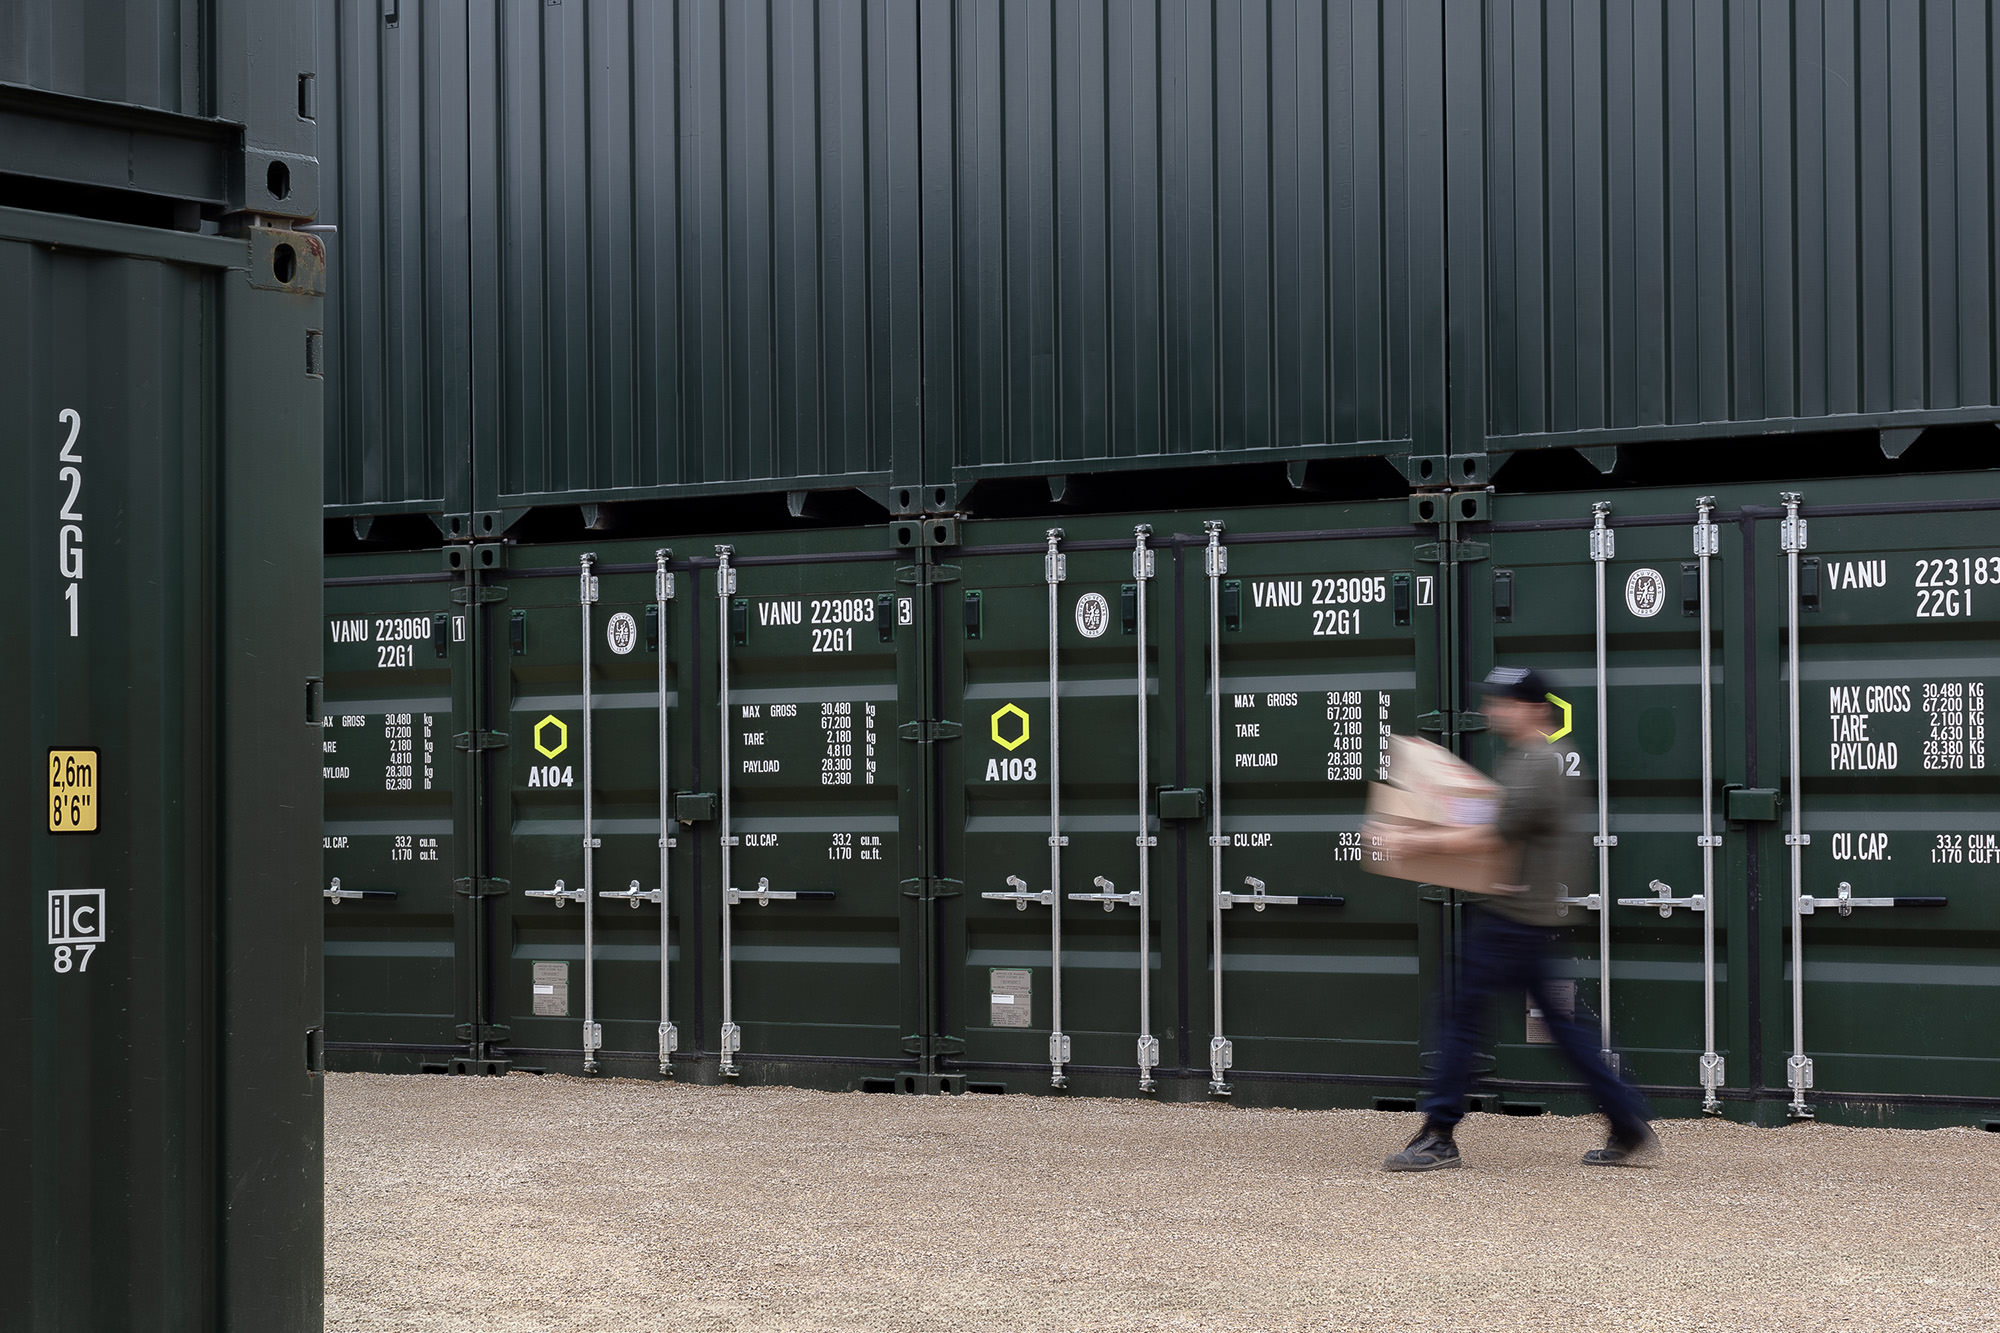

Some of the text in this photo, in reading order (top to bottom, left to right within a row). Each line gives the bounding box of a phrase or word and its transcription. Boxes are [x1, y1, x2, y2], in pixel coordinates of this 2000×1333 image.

[1828, 557, 2000, 589] VANU 223183
[1253, 581, 1301, 607] VANU
[1312, 577, 1385, 604] 223095
[1917, 588, 1971, 617] 22G1
[759, 601, 801, 625] VANU
[811, 599, 874, 623] 223083
[1313, 609, 1359, 635] 22G1
[331, 620, 368, 642] VANU
[376, 618, 430, 641] 223060
[812, 628, 851, 652] 22G1
[378, 645, 412, 667] 22G1
[1923, 683, 1983, 699] 30,480 KG
[1235, 695, 1254, 707] MAX
[1267, 693, 1297, 706] GROSS
[1379, 691, 1390, 708] kg
[1830, 685, 1910, 713] MAX GROSS
[1923, 697, 1984, 712] 67,200 LB
[743, 706, 760, 717] MAX
[771, 704, 796, 717] GROSS
[865, 702, 876, 717] kg
[1380, 705, 1389, 719] lb
[322, 716, 333, 727] AX
[343, 716, 365, 726] GROSS
[424, 712, 433, 727] kg
[866, 716, 874, 729] lb
[1931, 712, 1984, 727] 2,100 KG
[424, 726, 432, 738] lb
[1236, 724, 1259, 737] TARE
[1380, 722, 1391, 737] kg
[1831, 715, 1869, 741] TARE
[1931, 726, 1984, 740] 4,630 LB
[744, 733, 764, 745] TARE
[866, 730, 877, 744] kg
[1379, 736, 1389, 750] lb
[323, 742, 336, 752] ARE
[424, 739, 434, 753] kg
[866, 744, 875, 757] lb
[1924, 740, 1984, 755] 28,380 KG
[424, 752, 433, 764] lb
[1236, 754, 1277, 767] PAYLOAD
[1379, 752, 1391, 767] kg
[1831, 742, 1897, 770] PAYLOAD
[1924, 755, 1984, 769] 62,570 LB
[323, 767, 349, 778] AYLOAD
[424, 765, 434, 779] kg
[744, 760, 779, 772] PAYLOAD
[866, 758, 877, 772] kg
[986, 758, 1036, 781] A103
[53, 756, 91, 791] 2,6m
[528, 766, 573, 787] A104
[866, 772, 875, 785] lb
[1379, 767, 1388, 780] lb
[424, 778, 433, 790] lb
[396, 836, 411, 847] 33.2
[746, 833, 881, 846] CU.CAP. 33.2 cu.m.
[1235, 834, 1272, 846] CU.CAP.
[1339, 833, 1361, 845] 33.2
[1833, 833, 1891, 860] CU.CAP.
[1937, 835, 1998, 848] 33.2 CU.M.
[861, 848, 881, 859] cu.ft.
[1932, 849, 1962, 863] 1,170
[54, 945, 95, 973] 87
